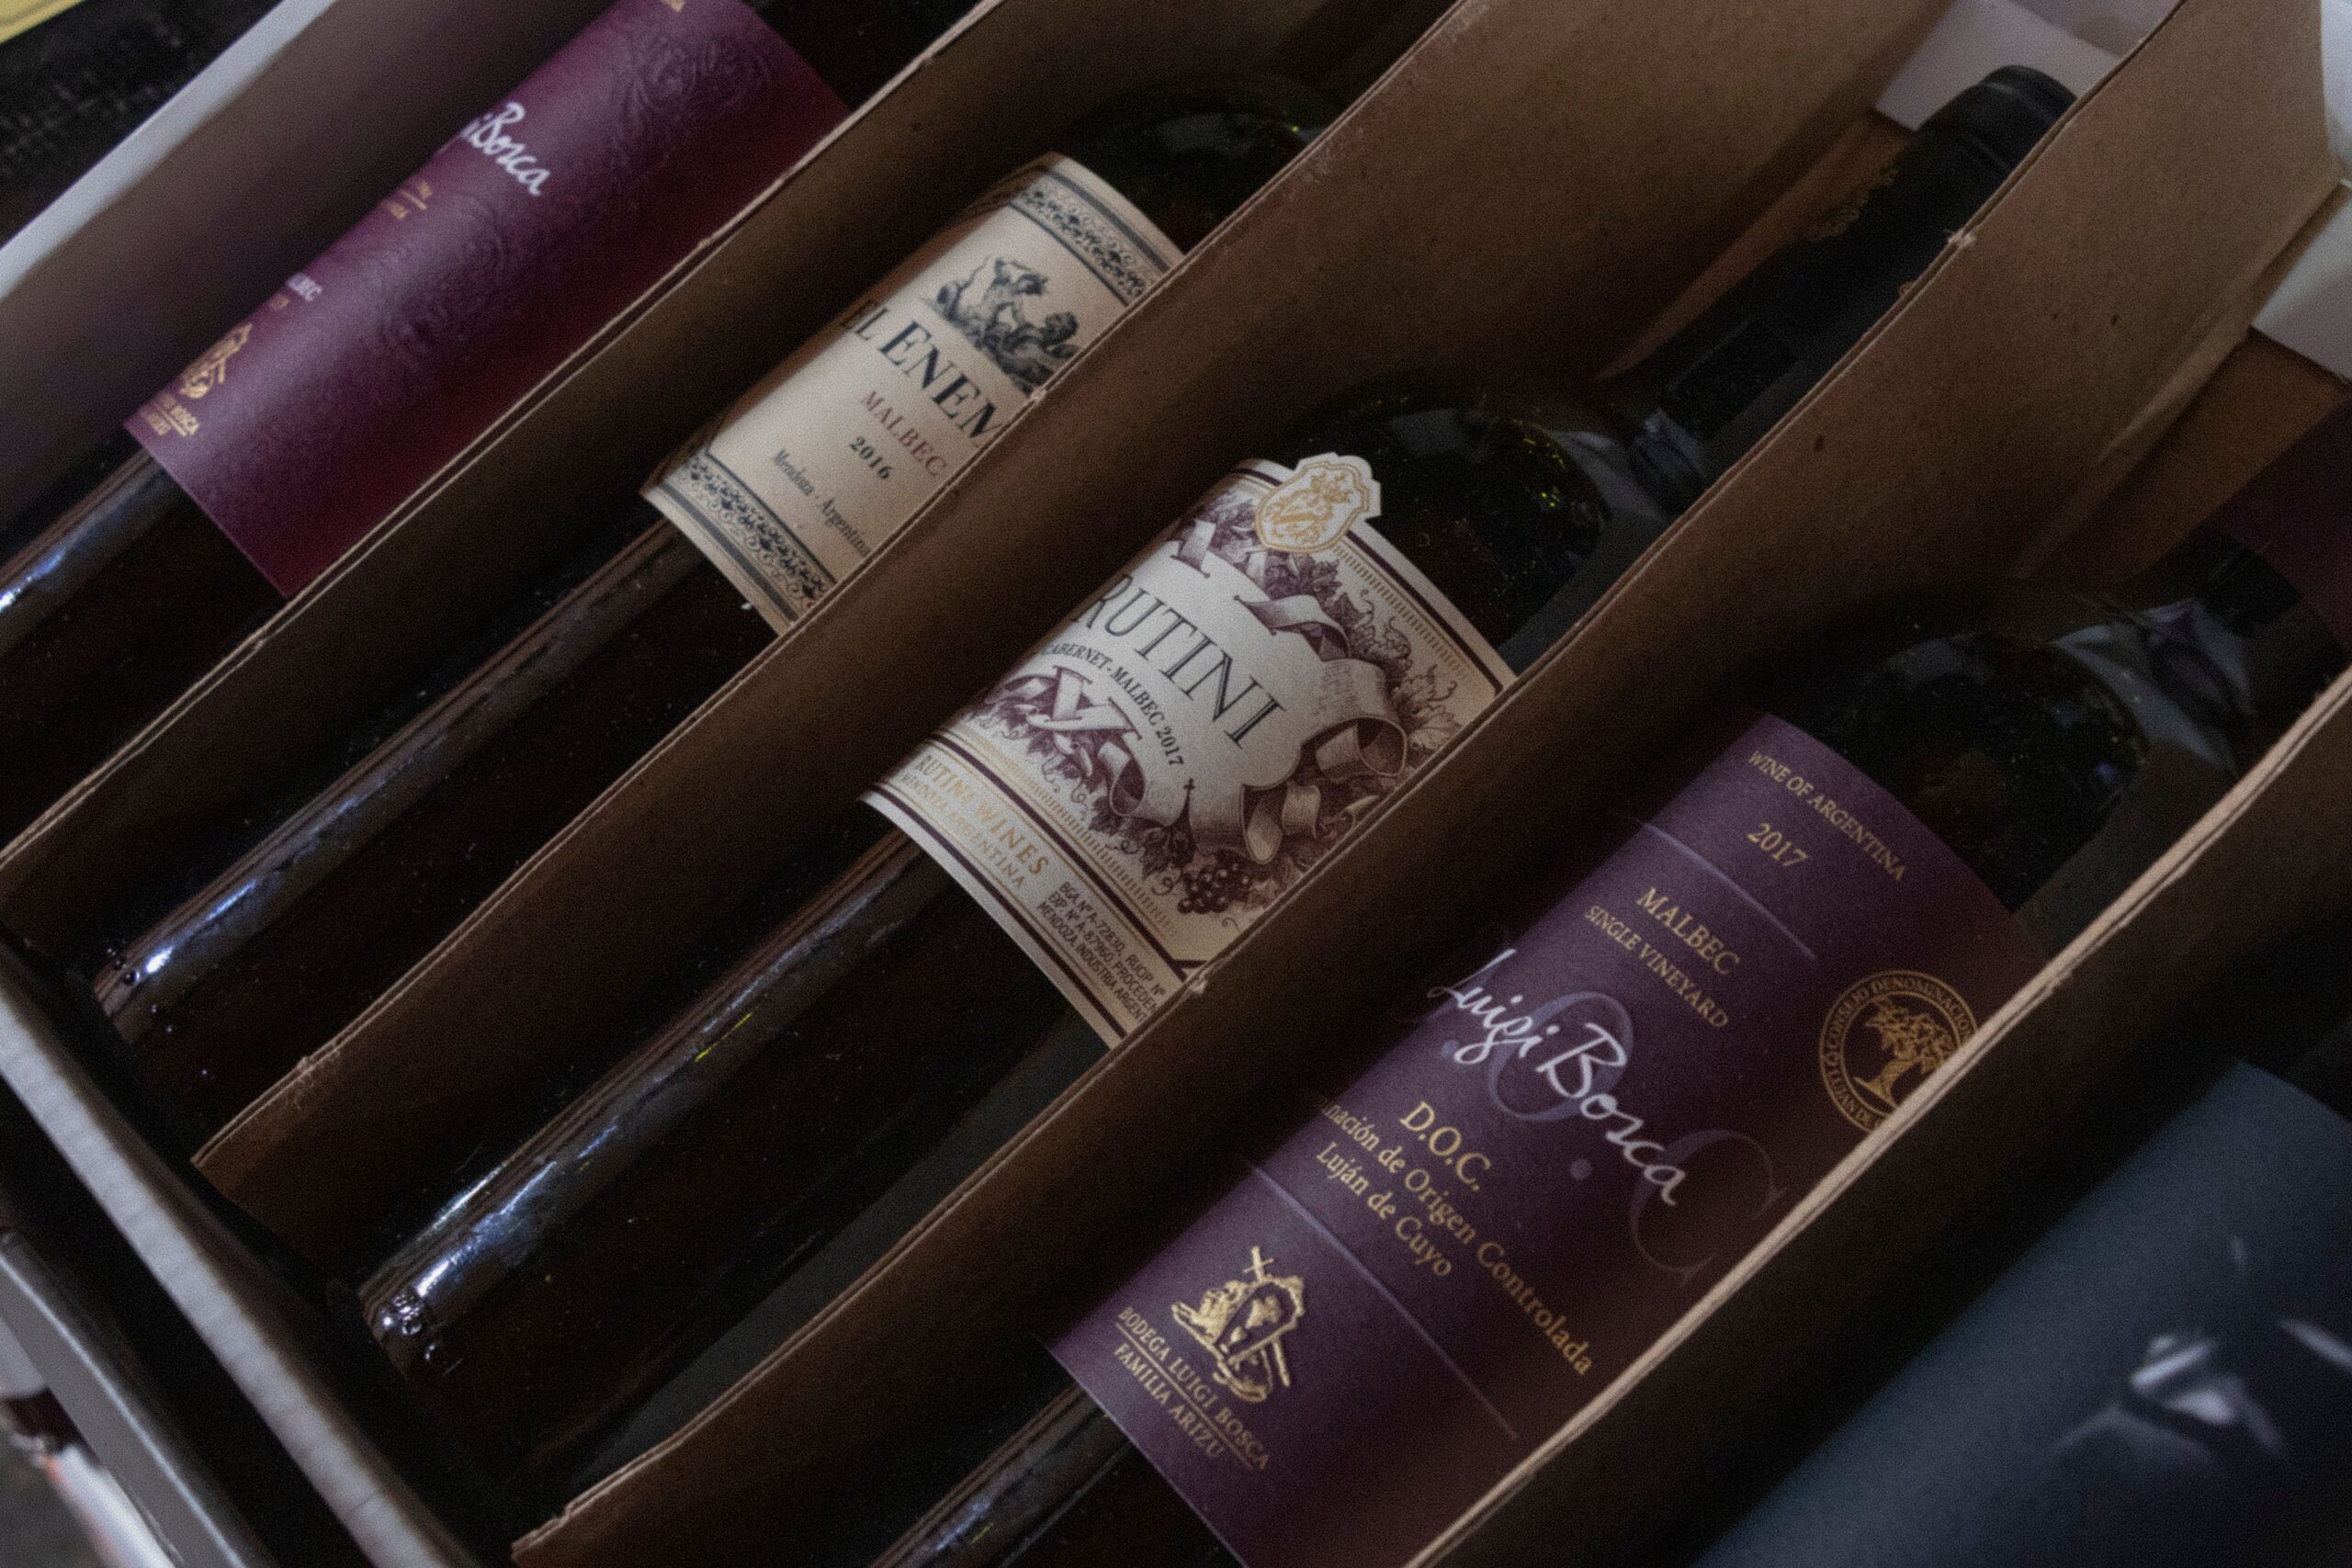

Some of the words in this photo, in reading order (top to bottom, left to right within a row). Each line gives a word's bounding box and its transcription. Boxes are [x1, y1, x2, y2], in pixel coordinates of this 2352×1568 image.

[469, 101, 550, 197] Bosca
[775, 450, 814, 496] Mendoza
[850, 436, 892, 479] 2016
[860, 391, 947, 476] MALBEC
[1155, 726, 1184, 766] 2017
[975, 800, 1049, 875] WINES
[1747, 749, 1791, 783] WINE
[1786, 775, 1815, 797] OF
[1806, 793, 1907, 882] ARGENTINA
[1747, 822, 1809, 866] 2017
[1075, 942, 1117, 989] INDUSTRIA
[1583, 905, 1643, 952] SINGLE
[1638, 942, 1730, 1029] VINEYARD
[1635, 886, 1740, 976] MALBEC
[1427, 948, 1561, 1065] Luigi
[1535, 1021, 1686, 1206] Bosca
[1400, 1100, 1492, 1191] D.O.C.
[1317, 1141, 1370, 1197] Luján
[1367, 1191, 1396, 1220] de
[1396, 1216, 1452, 1277] Cuyo
[1322, 1104, 1380, 1151] nación
[1378, 1145, 1407, 1174] de
[1404, 1168, 1476, 1245] Origen
[1476, 1242, 1593, 1376] Controlada
[1114, 1343, 1172, 1406] FAMILIA
[1169, 1404, 1225, 1458] ARIZU
[1116, 1305, 1172, 1361] BODEGA
[1169, 1356, 1218, 1410] LUIGI
[1215, 1406, 1271, 1470] BOSCA
